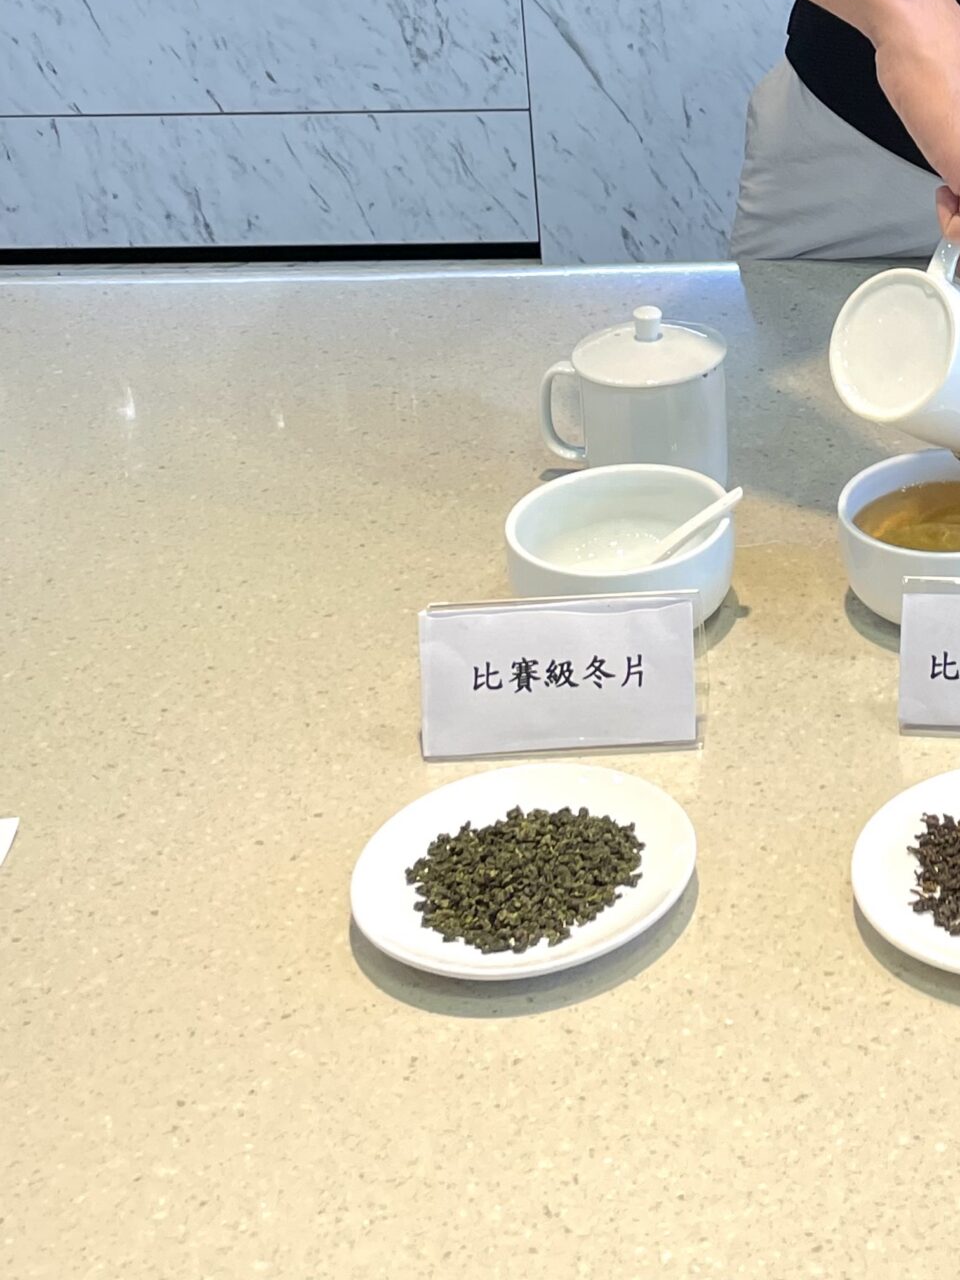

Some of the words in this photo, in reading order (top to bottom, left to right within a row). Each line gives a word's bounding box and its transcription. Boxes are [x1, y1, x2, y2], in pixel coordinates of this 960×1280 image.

[472, 654, 643, 694] 比賽級冬片
